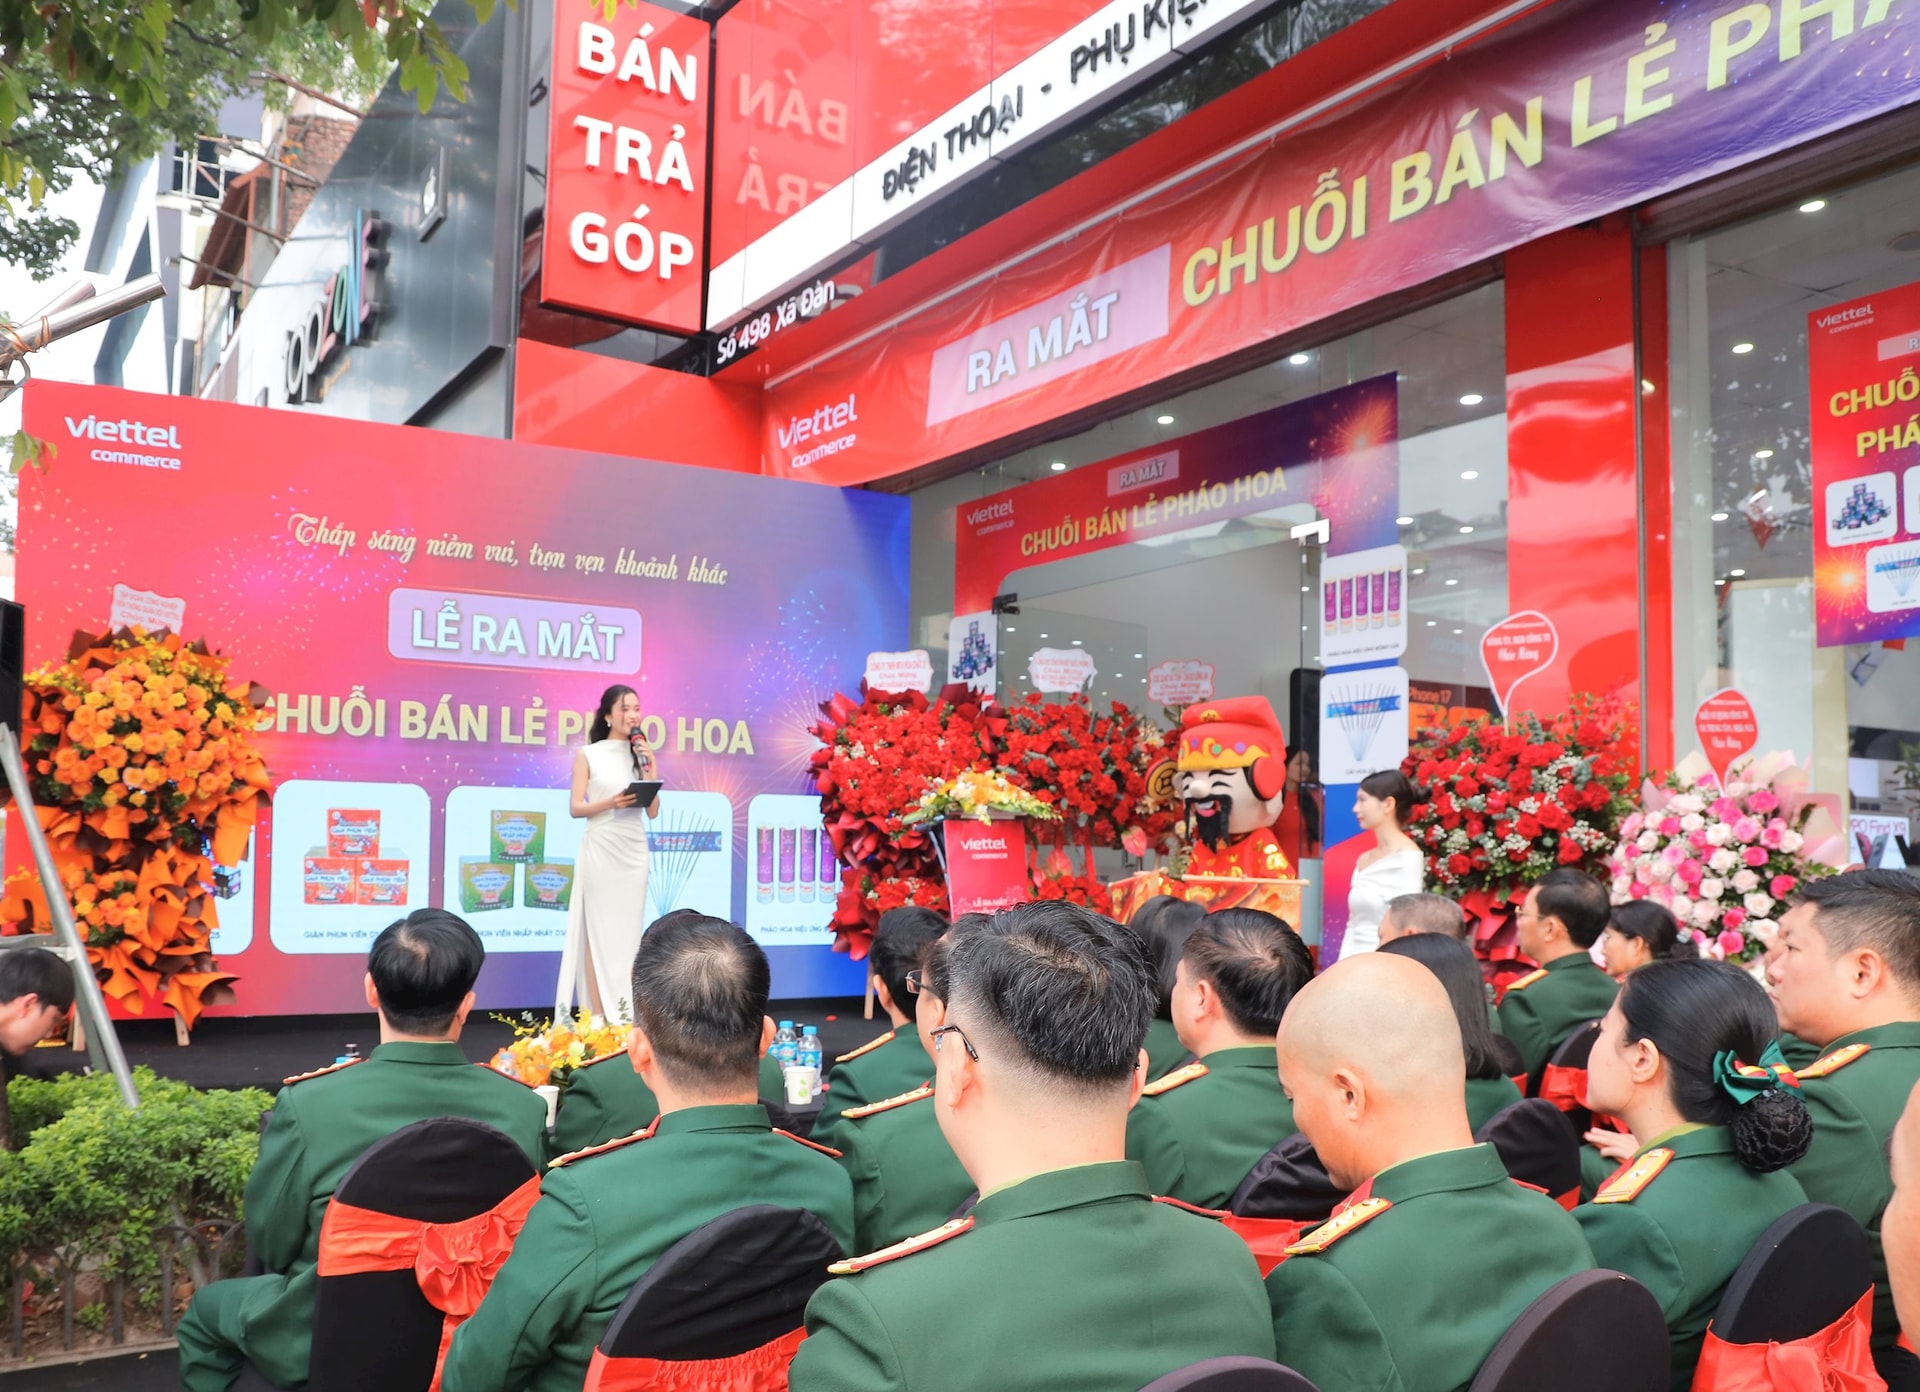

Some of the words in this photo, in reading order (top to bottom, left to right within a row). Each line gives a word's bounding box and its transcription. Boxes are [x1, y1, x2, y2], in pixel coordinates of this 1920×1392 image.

[577, 20, 698, 101] BÁN
[882, 142, 937, 200] ĐIỆN
[944, 85, 1024, 162] THOẠI
[1070, 12, 1136, 83] PHỤ
[573, 114, 695, 192] TRẢ
[1182, 168, 1367, 307] CHUỖI
[1388, 96, 1543, 224] BÁN
[1571, 22, 1674, 148] LẺ
[1706, 0, 1892, 92] PH
[569, 203, 695, 280] GÓP
[716, 327, 737, 365] Số
[738, 312, 771, 350] 498
[774, 296, 797, 332] Xã
[799, 279, 836, 318] Đàn
[966, 343, 1017, 393] RA
[1027, 291, 1120, 368] MẮT
[1816, 303, 1875, 328] viettel
[63, 415, 182, 450] viettel
[778, 393, 858, 449] viettel
[791, 432, 857, 469] commerce
[90, 447, 182, 470] commerce
[1120, 471, 1138, 488] RA
[1139, 460, 1168, 483] MẮT
[967, 498, 1015, 526] viettel
[976, 519, 1015, 536] commerce
[1021, 513, 1081, 556] CHUỖI
[1085, 507, 1128, 541] BÁN
[1132, 491, 1157, 530] LẺ
[1163, 479, 1228, 522] PHÁO
[1233, 465, 1288, 505] HOA
[287, 512, 356, 557] Thắp
[367, 529, 417, 564] sáng
[426, 532, 474, 560] niềm
[484, 539, 519, 567] vui,
[529, 542, 566, 571] trọn
[574, 553, 605, 576] vẹn
[614, 547, 679, 580] khoảnh
[686, 554, 728, 586] khắc
[411, 600, 461, 651] LỄ
[471, 618, 527, 656] RA
[537, 612, 624, 662] MẮT
[400, 693, 488, 742] BÁN
[501, 696, 547, 745] LẺ
[558, 710, 666, 751] PO
[676, 716, 755, 756] HOA
[960, 837, 1008, 851] viettel
